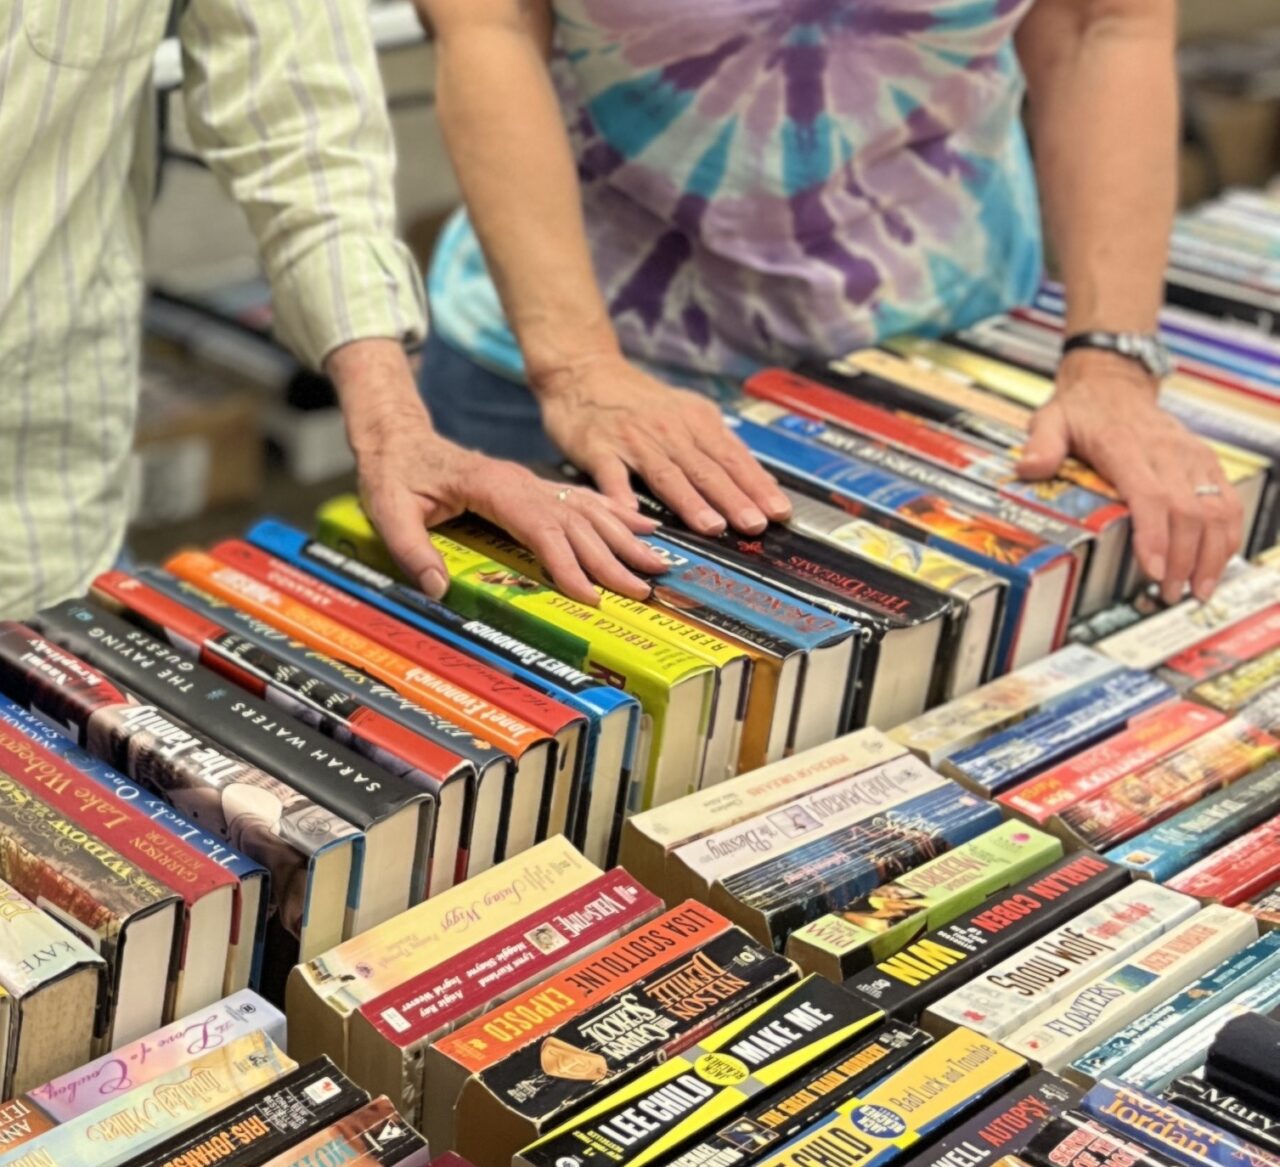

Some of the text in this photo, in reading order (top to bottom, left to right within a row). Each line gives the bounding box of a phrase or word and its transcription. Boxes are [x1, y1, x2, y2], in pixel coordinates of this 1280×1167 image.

[546, 597, 658, 652] REBECCA WELLS
[650, 612, 729, 652] REBECCA
[87, 626, 196, 693] THE PAYING
[125, 631, 195, 673] GUESTS
[462, 620, 594, 687] JANET EVANOVICH
[404, 666, 536, 741] Janet Evanovich
[120, 703, 244, 787] The Family
[230, 701, 381, 793] SARAH WATERS
[73, 787, 135, 830] Lake
[102, 770, 241, 870] The Lucky One
[47, 815, 135, 881] WIDOW
[128, 835, 201, 884] GARRISON
[440, 877, 525, 933] Susan Wiggs
[585, 891, 628, 922] VEILS
[970, 854, 1110, 933] HARLAN COBEN
[553, 913, 588, 938] TIME
[15, 940, 78, 973] KAYE
[465, 940, 528, 979] Maggie Shayne
[477, 952, 536, 988] Lynn Kurland
[573, 908, 715, 997] LISA SCOTTOLINE
[875, 938, 968, 988] WIN
[985, 944, 1071, 998] Snow
[1042, 926, 1117, 976] Wolf
[439, 989, 465, 1008] Angie
[482, 986, 577, 1043] EXPOSED
[579, 993, 660, 1048] SCHOOL
[668, 972, 750, 1024] NELSON
[1045, 982, 1127, 1038] FLOATERS
[157, 1014, 221, 1056] Love
[599, 1019, 671, 1064] CHARM
[730, 1000, 835, 1065] MAKE ME
[41, 1059, 134, 1101] Cowboy
[888, 1093, 914, 1114] Bad
[905, 1074, 947, 1106] Luck
[946, 1041, 999, 1077] Trouble
[597, 1104, 661, 1147] LEE
[637, 1073, 715, 1125] CHILD
[756, 1108, 784, 1129] THE
[977, 1094, 1051, 1149] AUTOPSY
[1100, 1098, 1210, 1160] Jordan
[1200, 1086, 1280, 1133] Mary
[161, 1115, 271, 1167] IRIS JOHANS
[790, 1126, 873, 1167] CHILD
[929, 1140, 992, 1167] WELL
